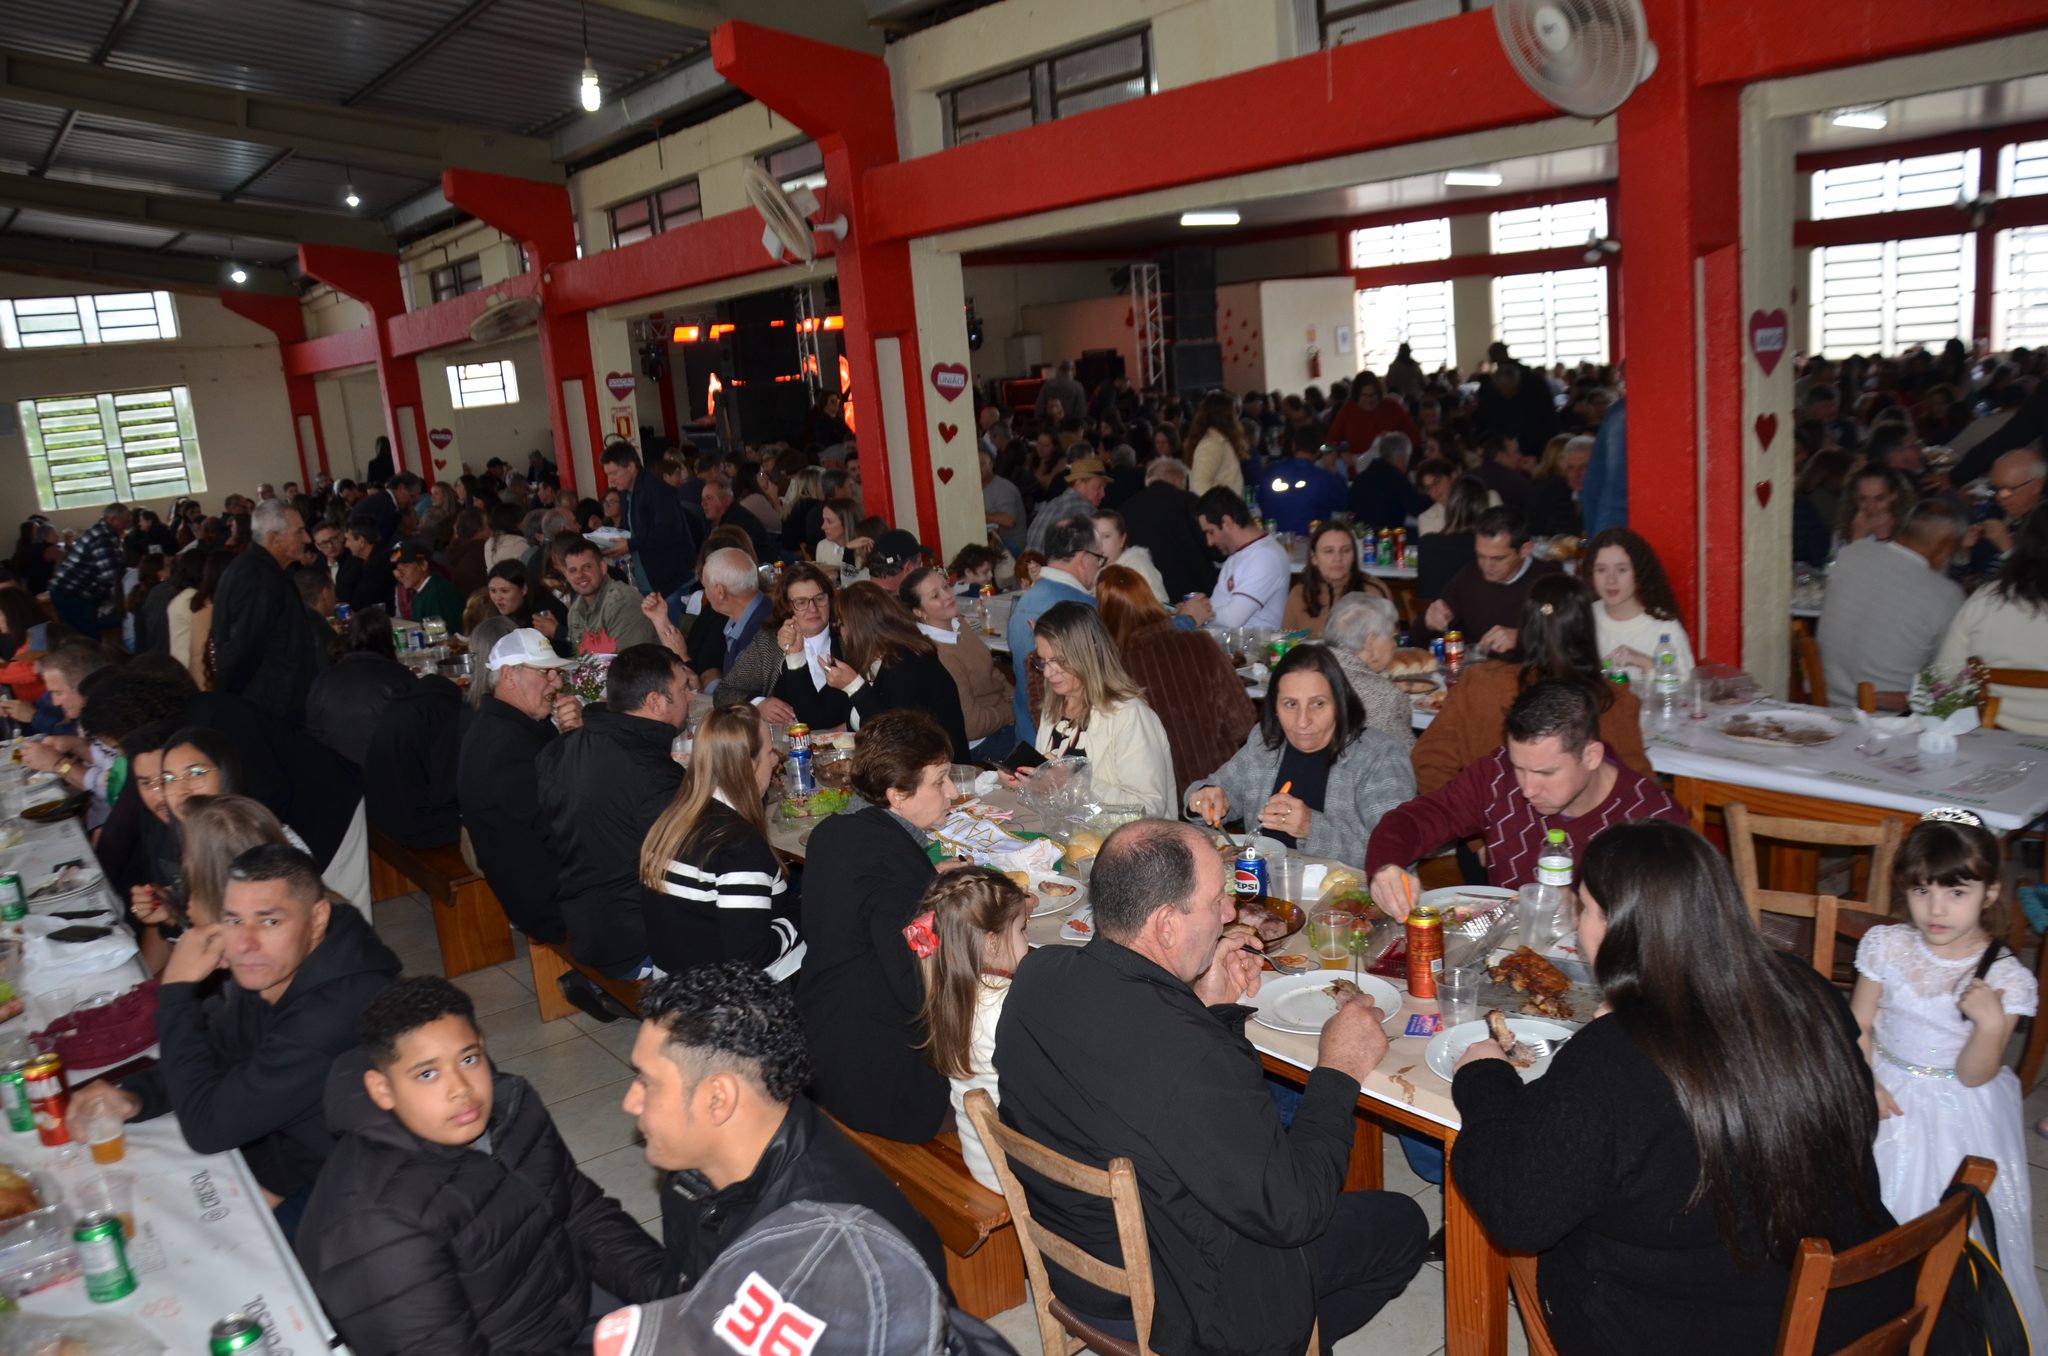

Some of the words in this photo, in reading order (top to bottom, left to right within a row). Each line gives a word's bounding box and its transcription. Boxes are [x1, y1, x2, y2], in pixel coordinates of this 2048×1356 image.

[938, 373, 965, 386] UNIÃO
[1235, 882, 1258, 891] EPSI
[190, 1169, 221, 1208] CRESOL
[724, 1282, 816, 1356] 36
